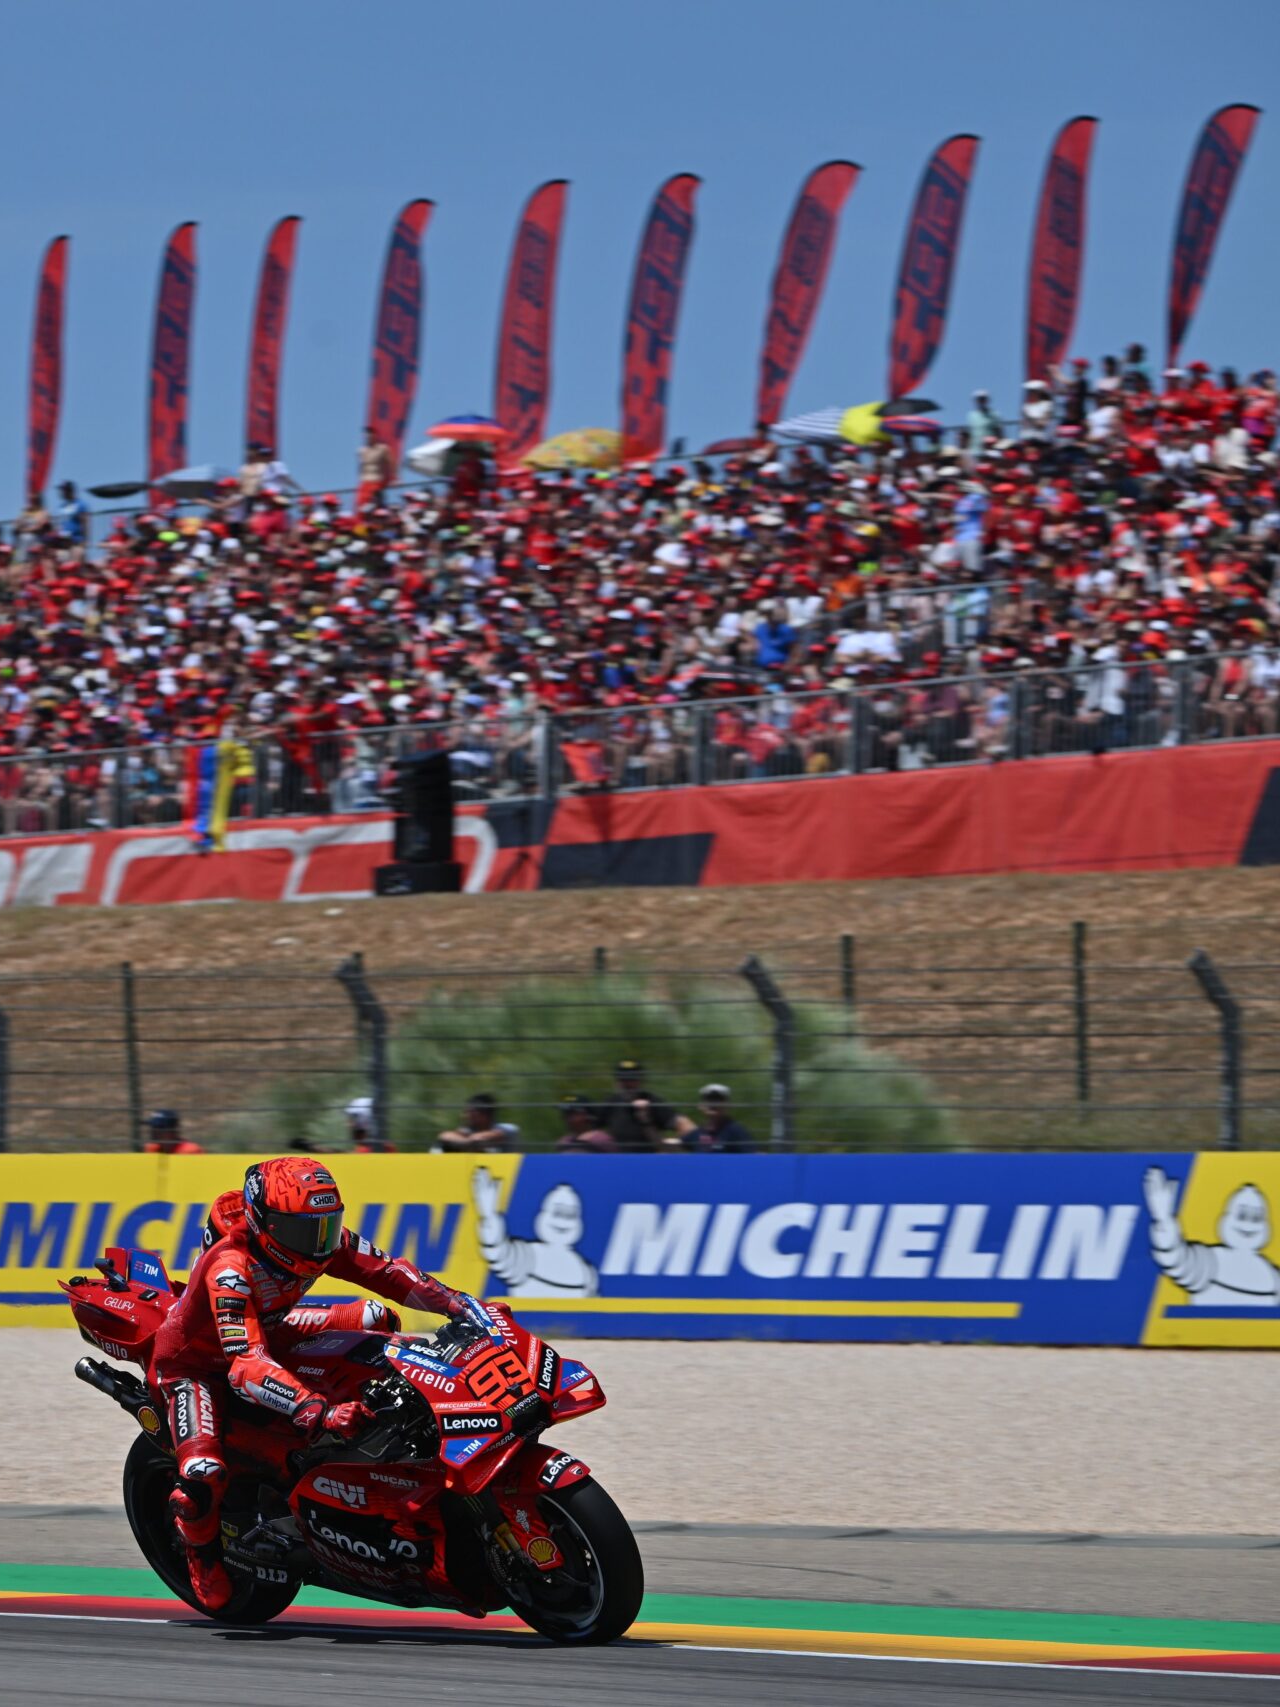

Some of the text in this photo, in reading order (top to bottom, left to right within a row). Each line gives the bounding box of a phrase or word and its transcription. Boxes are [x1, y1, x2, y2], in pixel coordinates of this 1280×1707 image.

[313, 1195, 335, 1206] SHOEI
[600, 1202, 1139, 1280] MICHELIN
[267, 1244, 293, 1265] Lenovo
[144, 1263, 158, 1277] TIM
[409, 1344, 441, 1357] WRS
[297, 1366, 325, 1376] DUCATI
[402, 1354, 448, 1373] ADVANCE
[539, 1348, 554, 1389] Lenovo
[468, 1348, 536, 1409] 93
[570, 1370, 588, 1381] TIM
[263, 1378, 294, 1398] Lenovo
[174, 1383, 188, 1437] Lenovo
[198, 1380, 215, 1437] DUCATI
[263, 1391, 291, 1411] Unipol
[443, 1418, 498, 1430] Lenovo
[463, 1439, 482, 1455] TIM
[542, 1454, 576, 1484] Leno
[370, 1472, 419, 1488] DUCATI
[313, 1476, 367, 1508] GIVI
